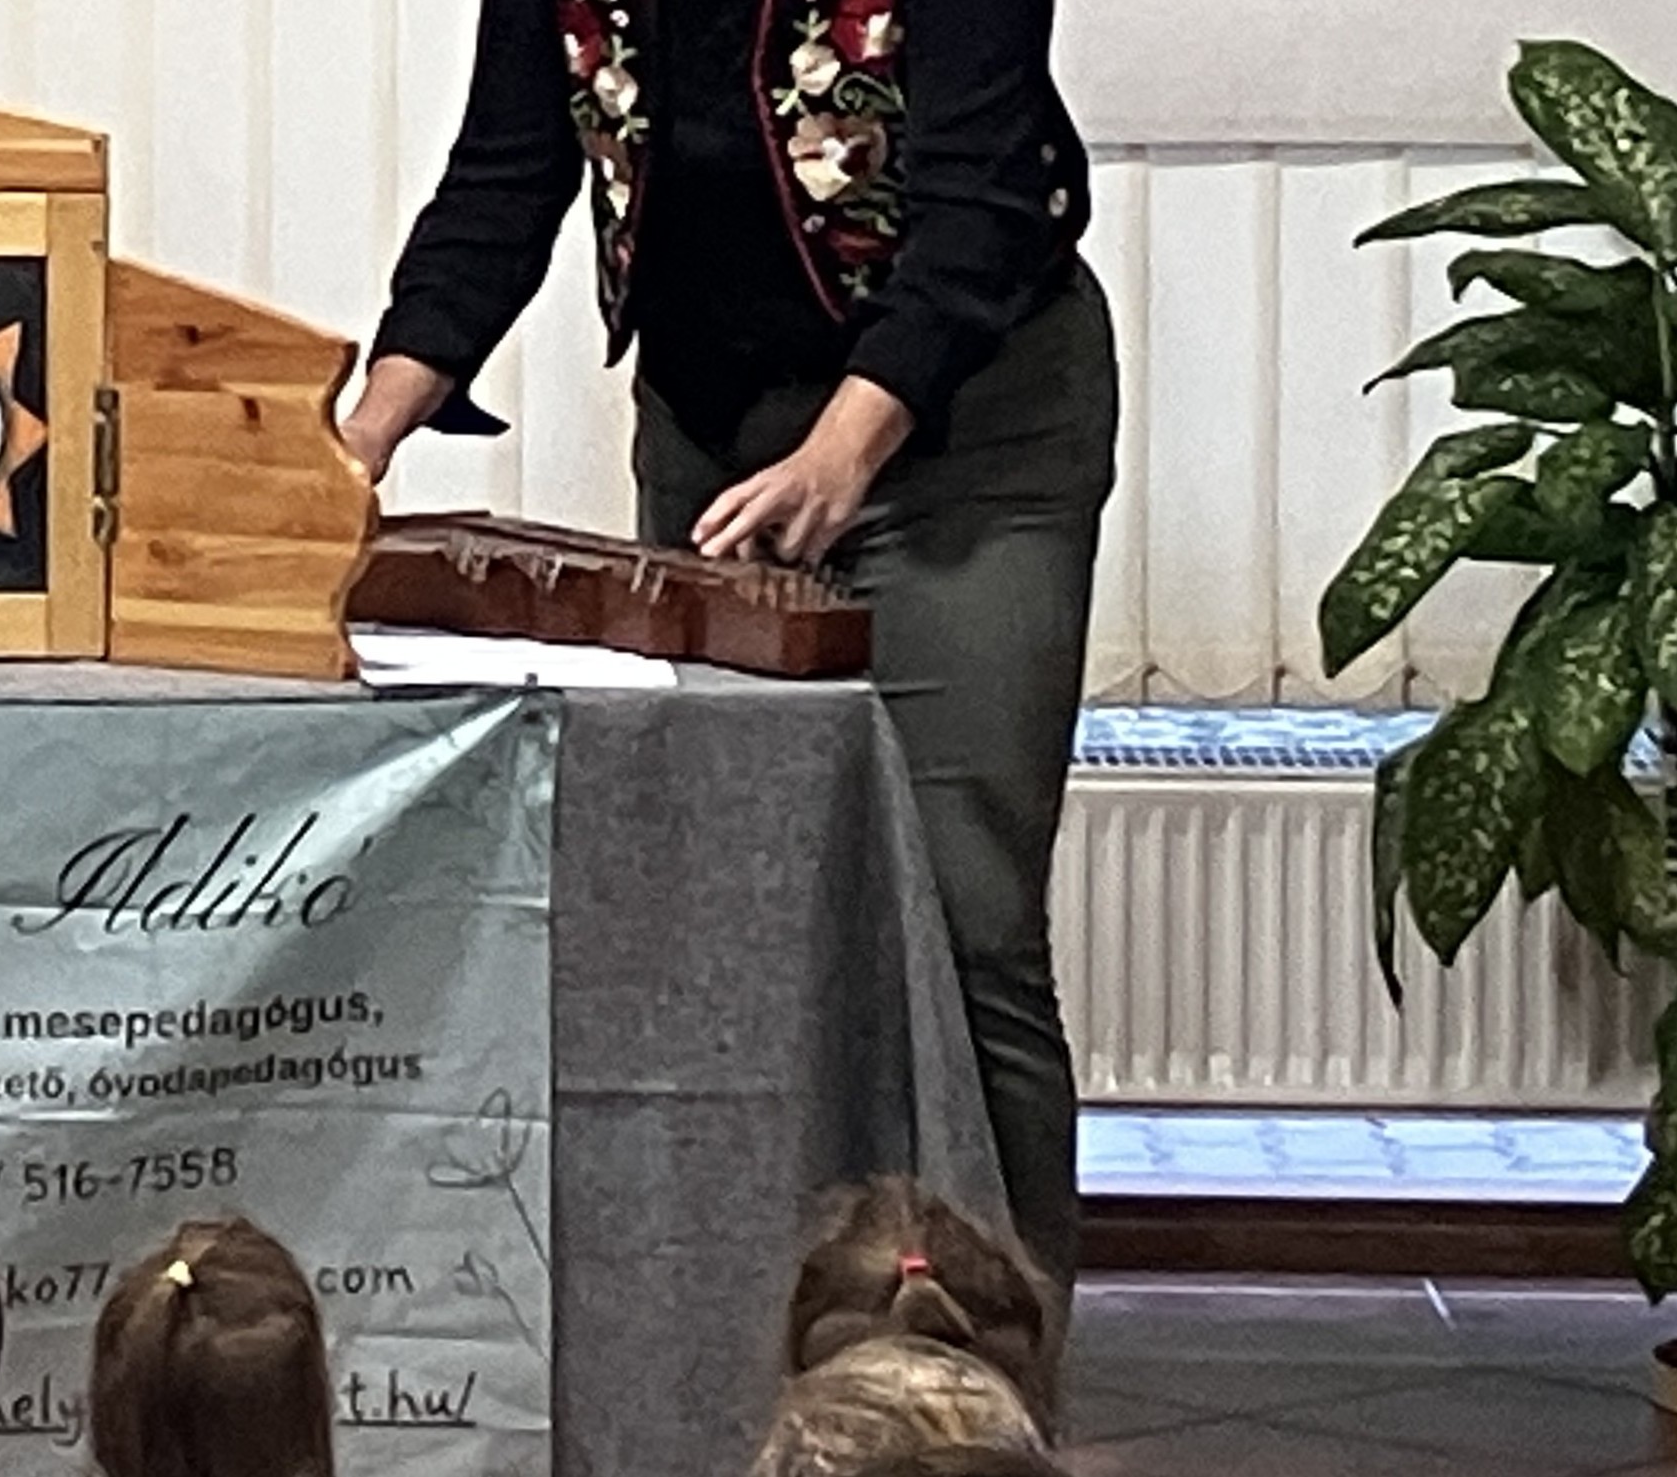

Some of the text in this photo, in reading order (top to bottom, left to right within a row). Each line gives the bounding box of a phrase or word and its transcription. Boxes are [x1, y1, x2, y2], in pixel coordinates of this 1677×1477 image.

[10, 812, 373, 935] Ildikó
[3, 991, 383, 1048] mesepedagógus,
[88, 1039, 424, 1098] óvodapedagógus
[24, 1146, 238, 1204] 516-7558
[6, 1261, 416, 1308] ko77 com
[339, 1370, 478, 1426] t.hu/
